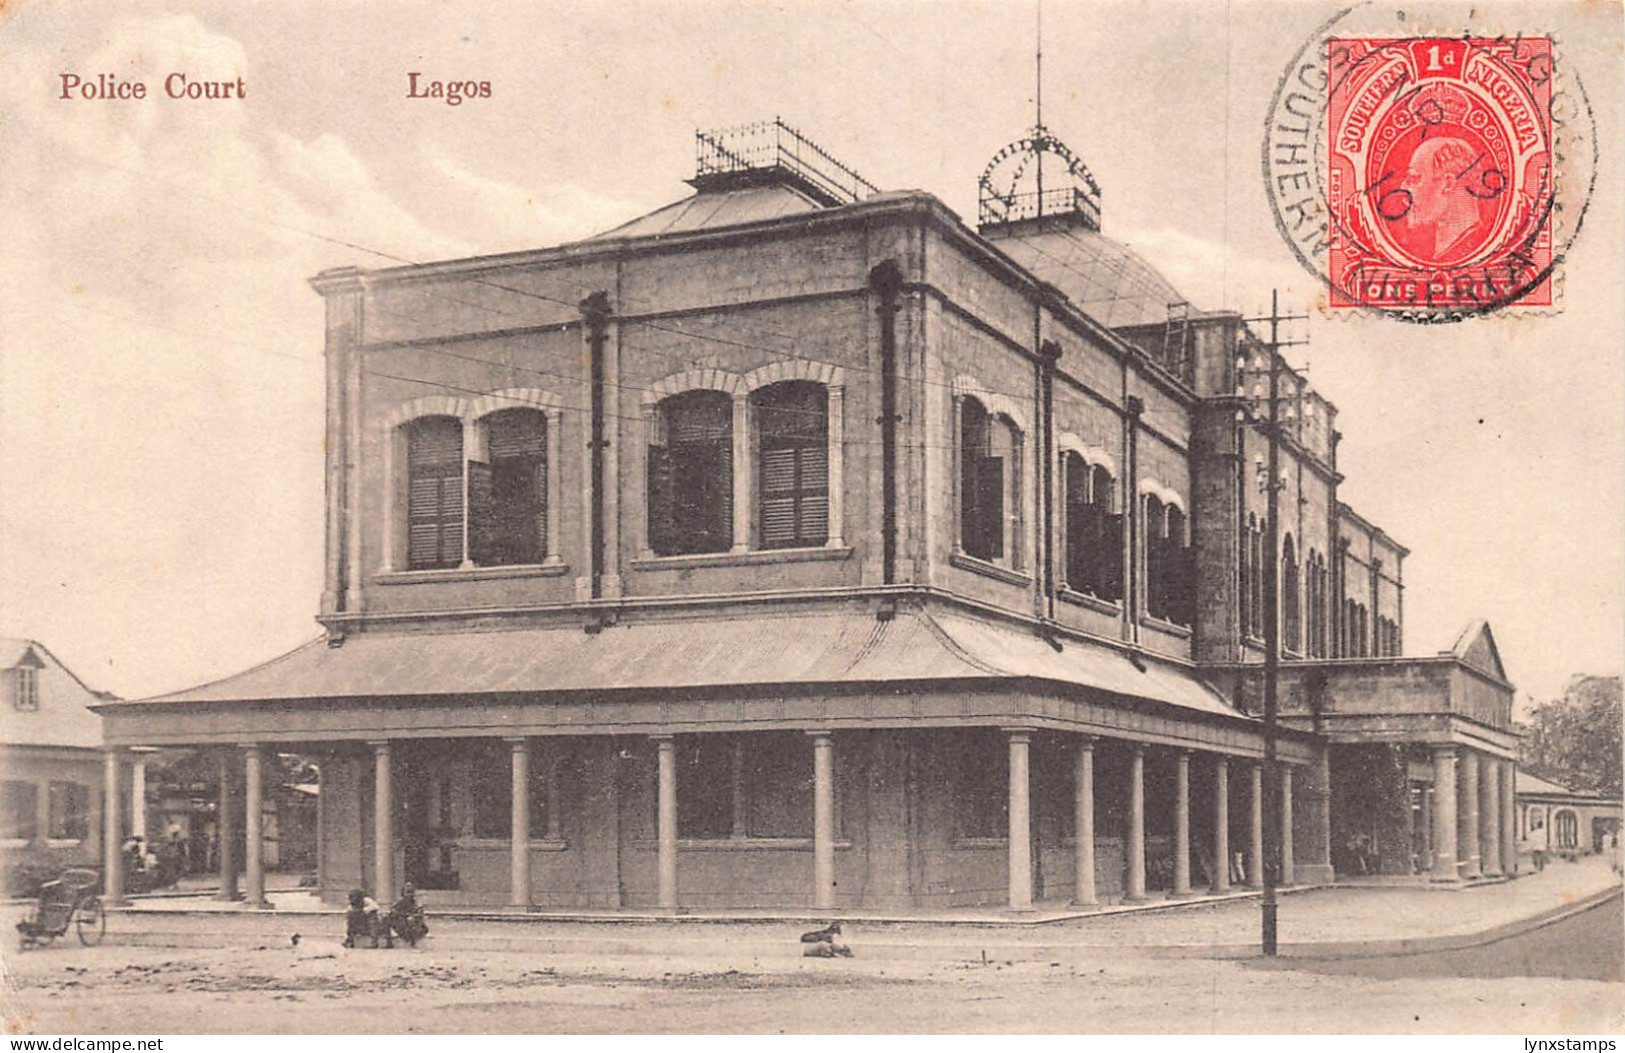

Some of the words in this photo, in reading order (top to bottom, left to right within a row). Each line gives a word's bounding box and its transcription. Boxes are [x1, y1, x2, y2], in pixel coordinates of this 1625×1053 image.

[1427, 46, 1455, 71] 1d
[59, 73, 147, 99] Police
[164, 73, 246, 99] Court
[406, 72, 492, 106] Lagos
[1340, 62, 1408, 153] SOUTHERN
[1470, 62, 1539, 152] NIGERIA
[1456, 152, 1507, 199] 19
[1364, 171, 1413, 221] 10
[1368, 283, 1416, 298] ONE
